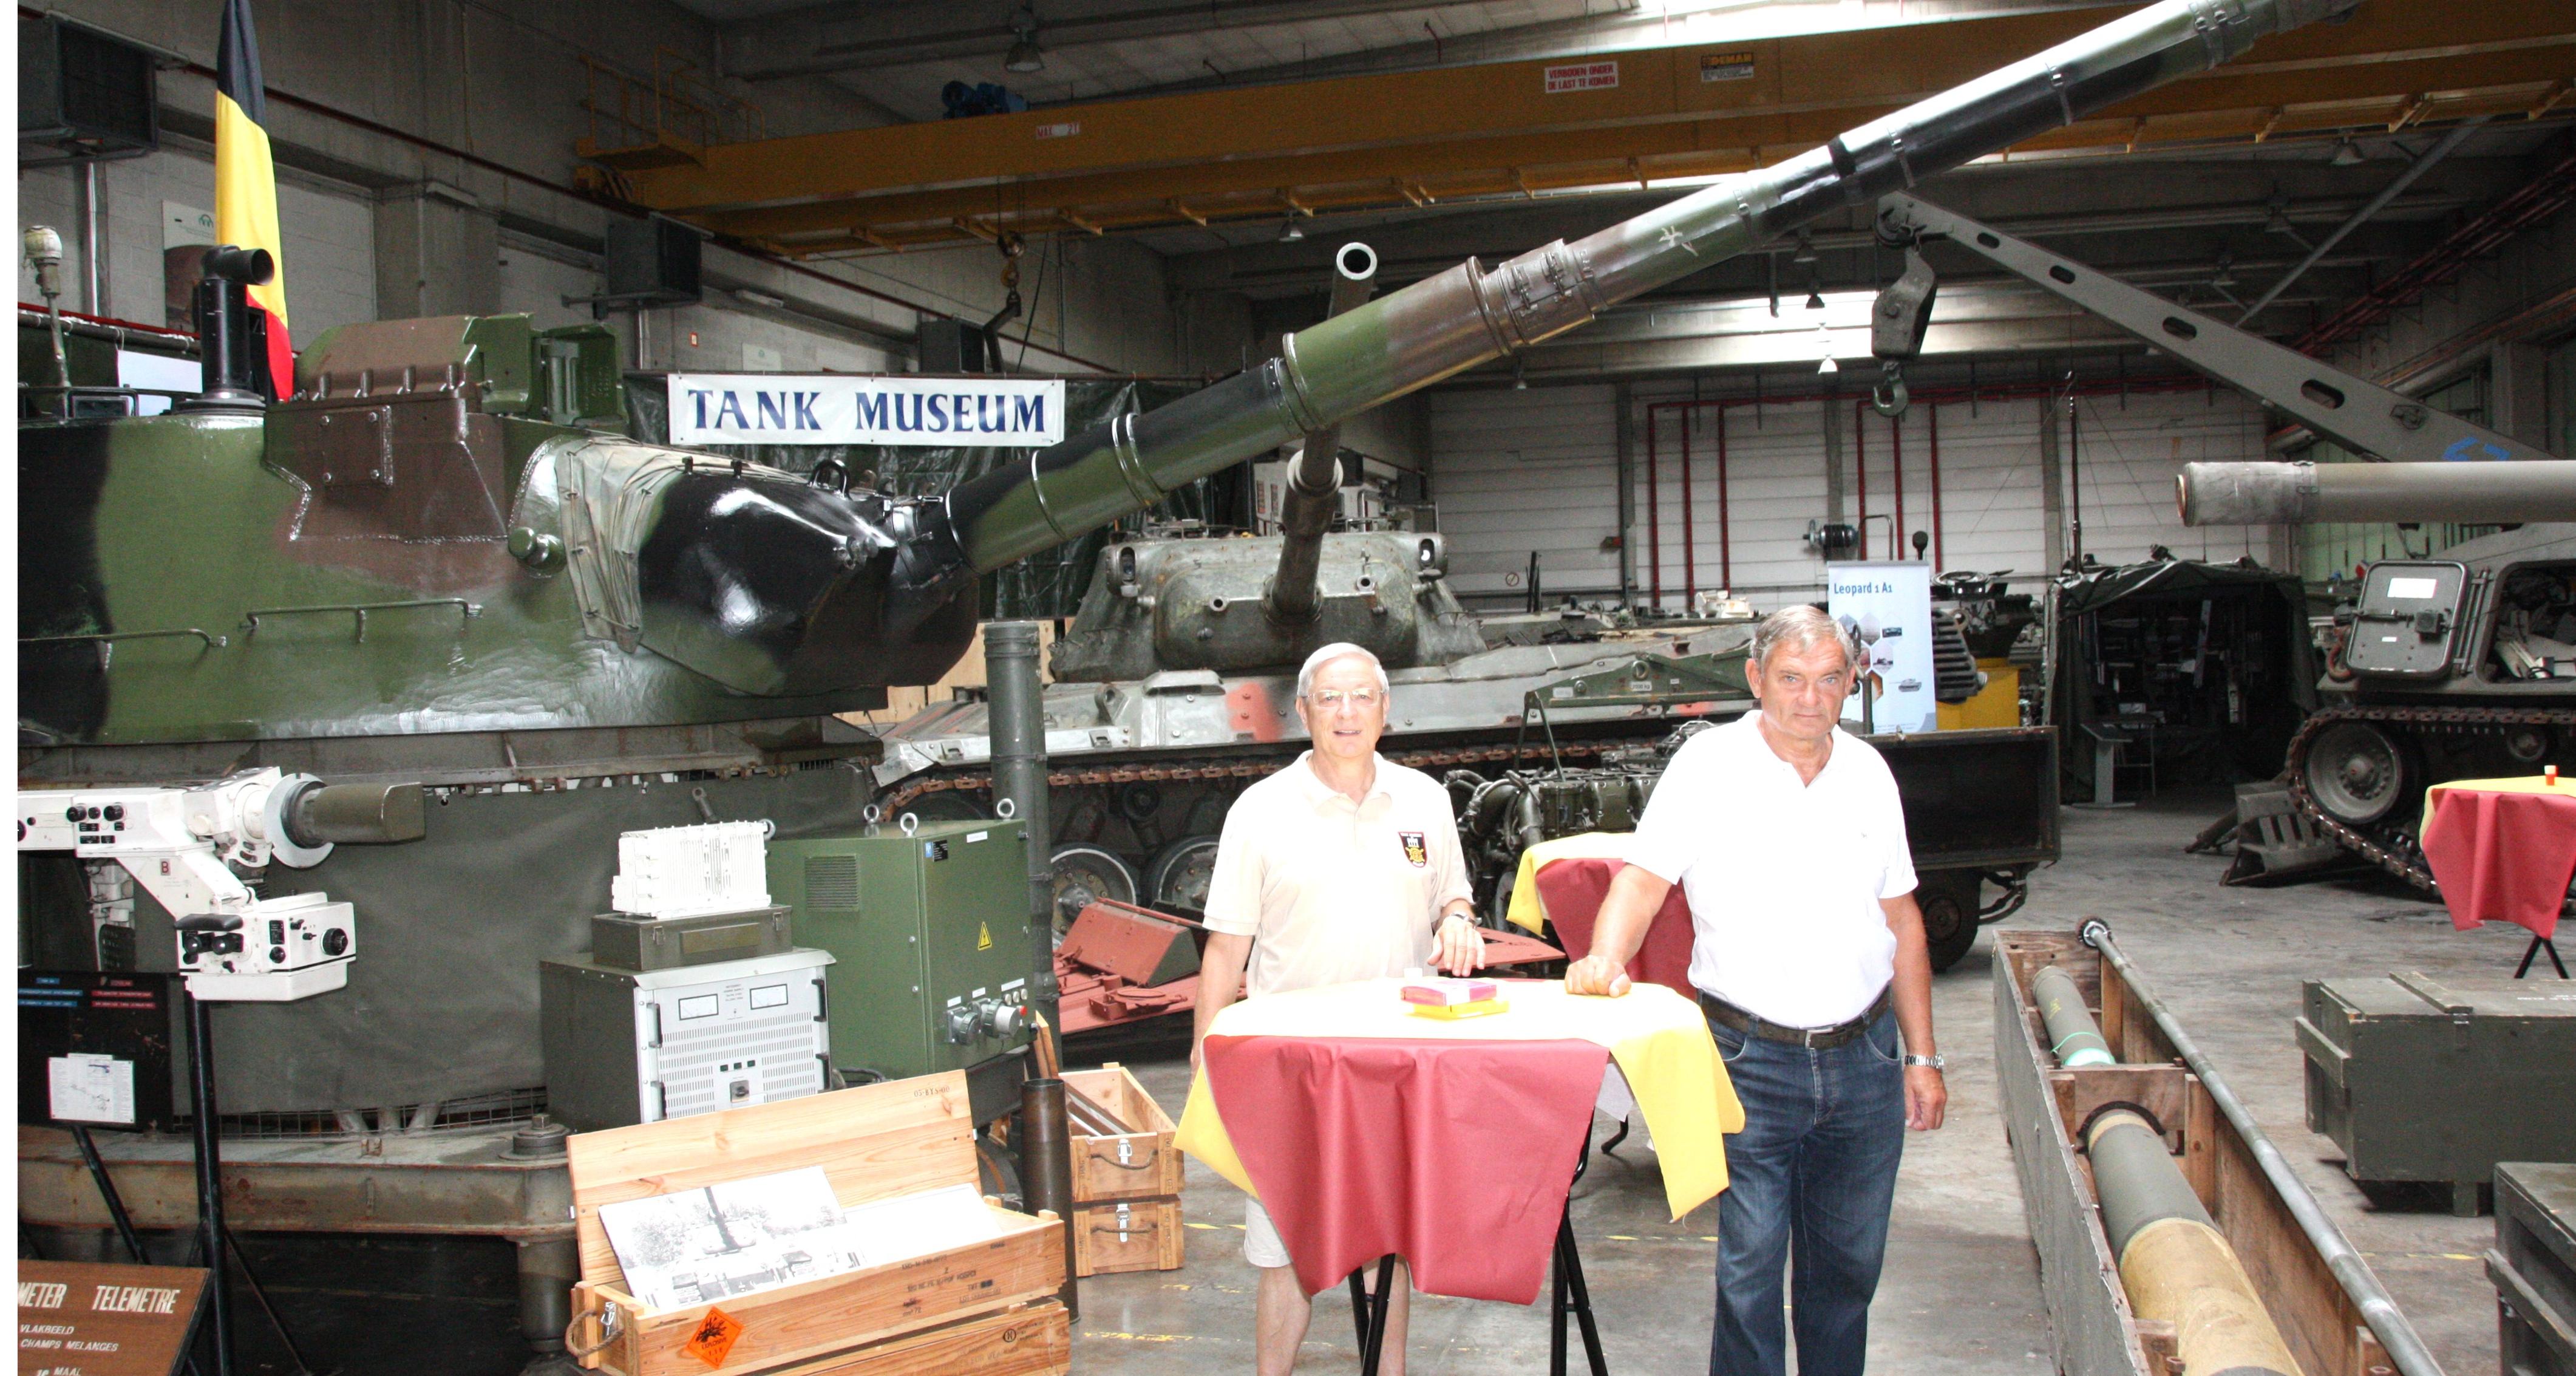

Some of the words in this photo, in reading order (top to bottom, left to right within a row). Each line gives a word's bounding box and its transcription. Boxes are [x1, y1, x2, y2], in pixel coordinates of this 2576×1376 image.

[1549, 67, 1586, 78] VERBODEN
[1589, 64, 1613, 75] ONDER
[1548, 80, 1555, 90] DE
[1558, 79, 1575, 89] LAST
[1578, 78, 1586, 87] TE
[1589, 76, 1616, 86] KOMEN
[687, 389, 822, 431] TANK
[854, 392, 1045, 433] MUSEUM
[1833, 582, 1872, 596] Leopard
[1882, 583, 1893, 593] A1
[161, 861, 169, 873] B
[92, 1285, 181, 1313] TELEMETRE
[20, 1324, 75, 1335] VLAKBEELD
[20, 1338, 63, 1349] CHAMPS
[66, 1340, 119, 1352] MELANGES
[701, 1337, 727, 1349] EXPLOSIVE
